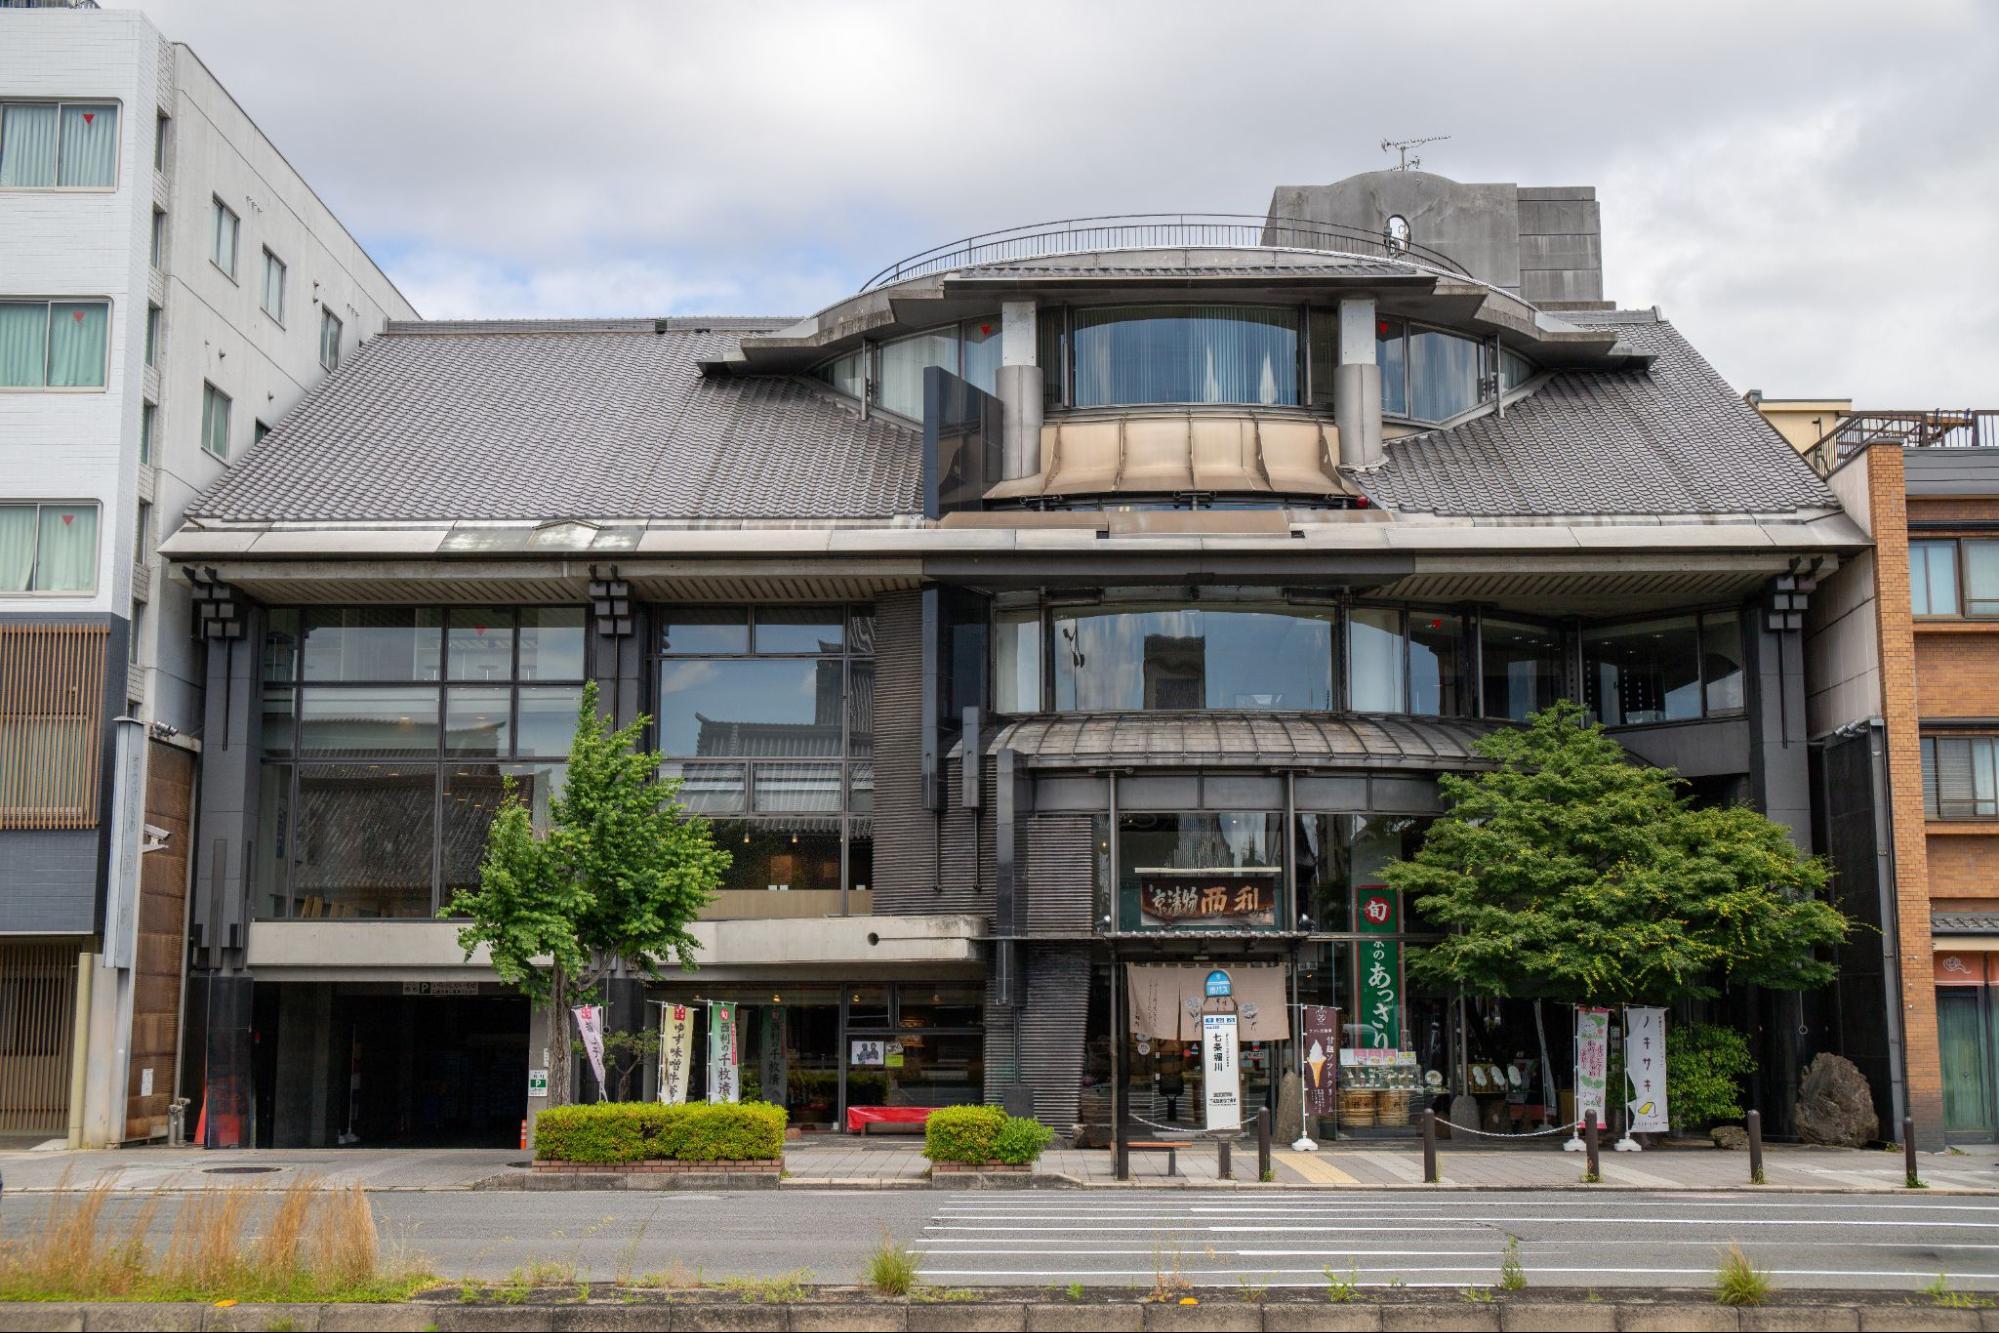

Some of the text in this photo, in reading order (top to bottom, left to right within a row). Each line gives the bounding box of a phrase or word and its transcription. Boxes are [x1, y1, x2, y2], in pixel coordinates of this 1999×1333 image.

[1368, 900, 1387, 921] 旬
[422, 983, 429, 993] P
[1213, 1033, 1223, 1072] 七条堀川
[536, 1080, 542, 1088] P
